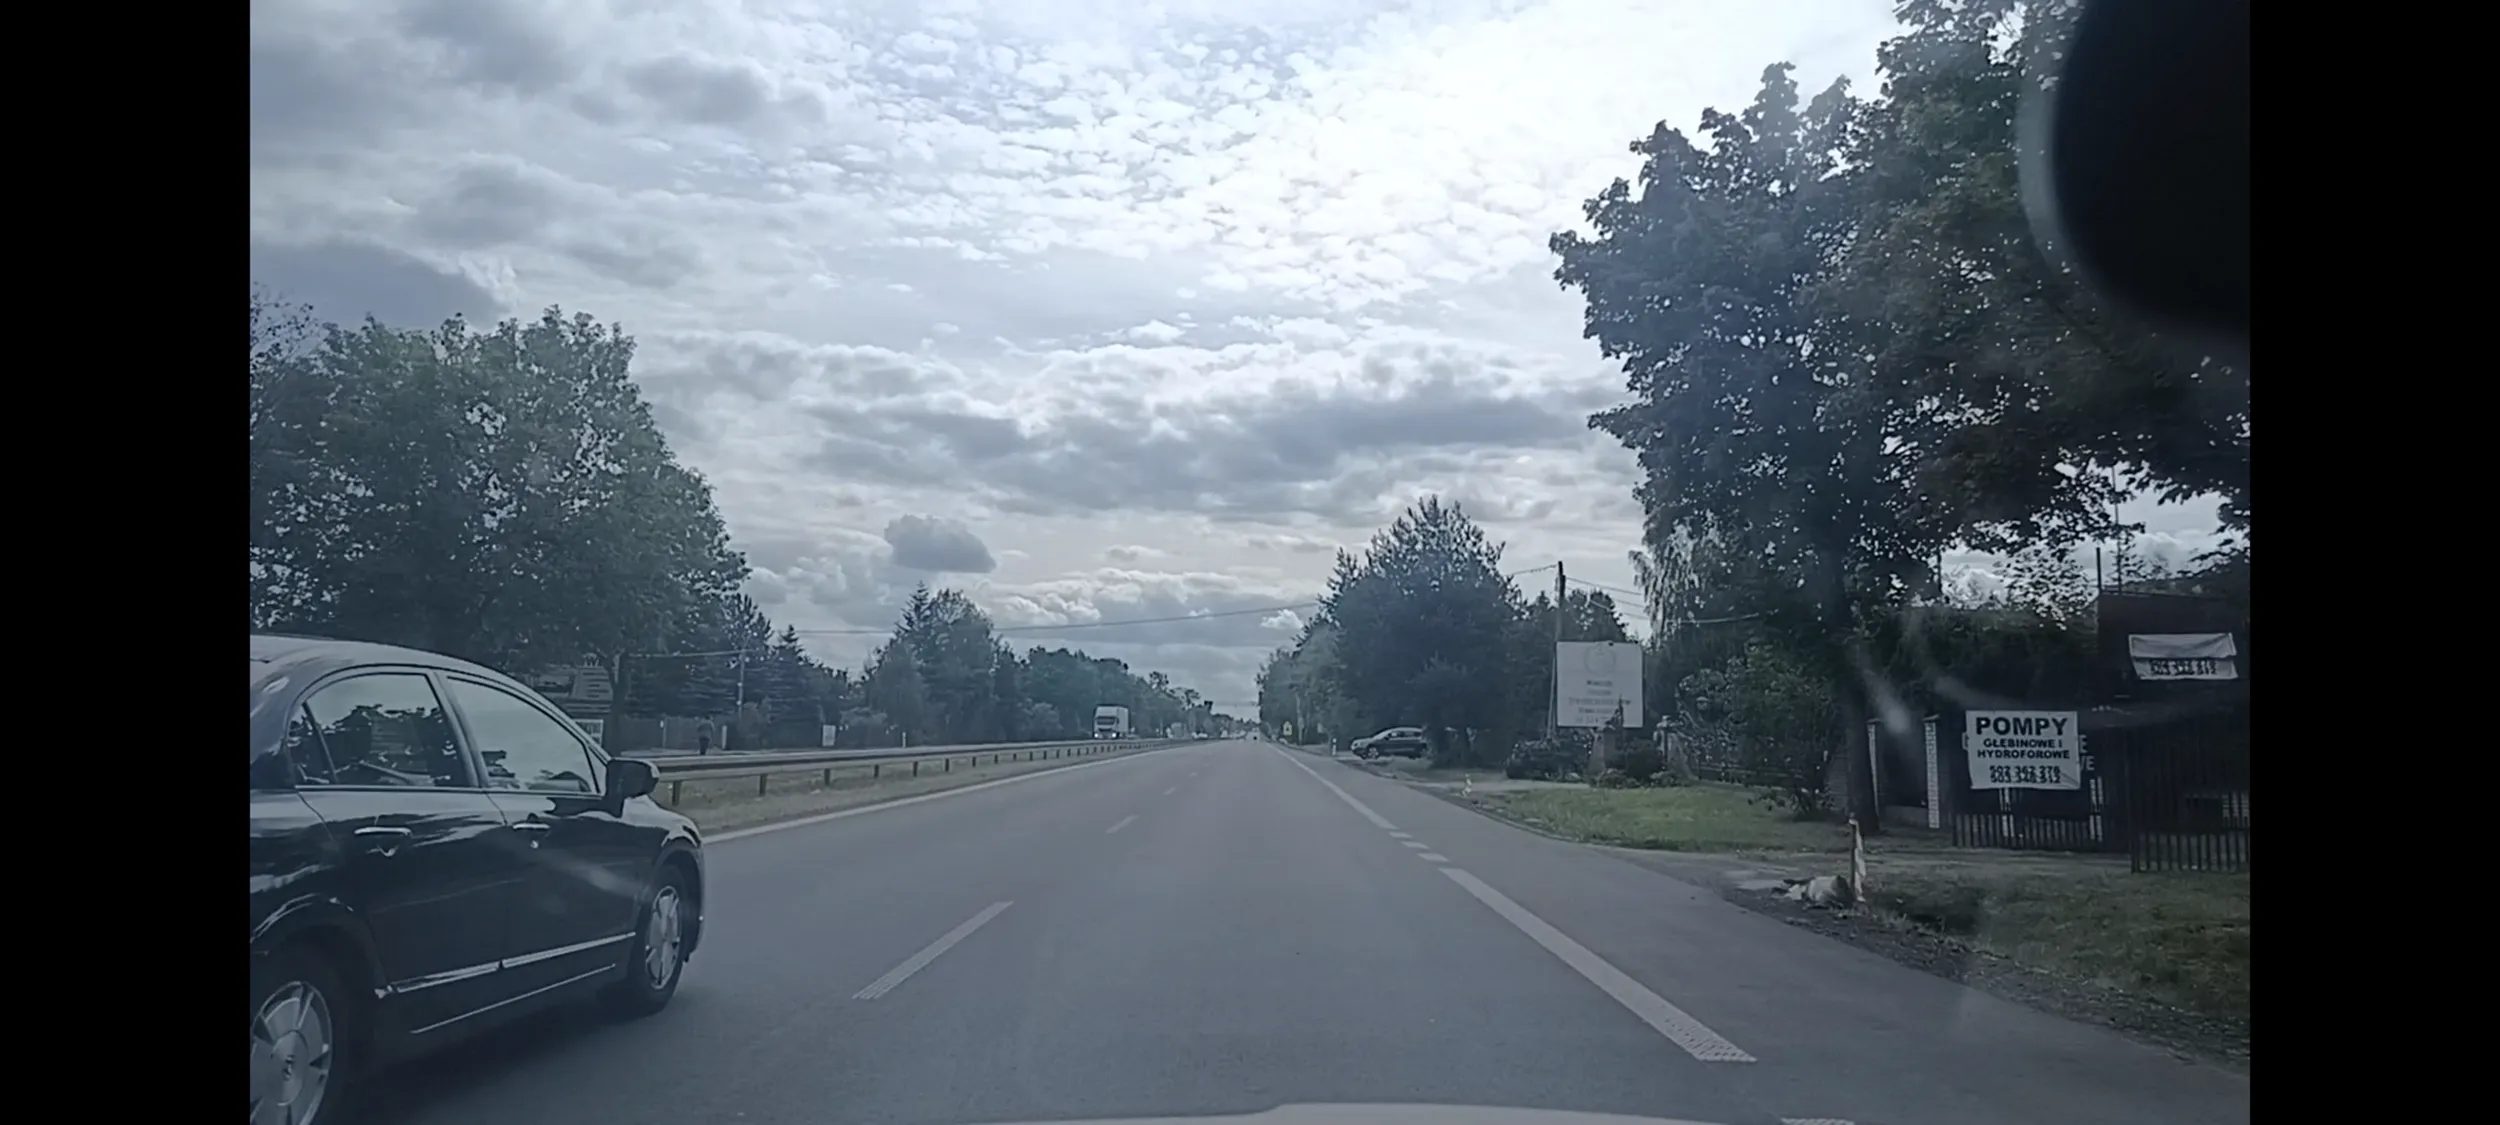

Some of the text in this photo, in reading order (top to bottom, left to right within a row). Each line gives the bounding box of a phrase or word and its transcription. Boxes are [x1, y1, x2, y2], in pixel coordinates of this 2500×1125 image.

[1976, 716, 2067, 735] POMPY
[1983, 738, 2055, 749] GŁĘBINOWE
[1977, 749, 2070, 759] HYDROFOROWE
